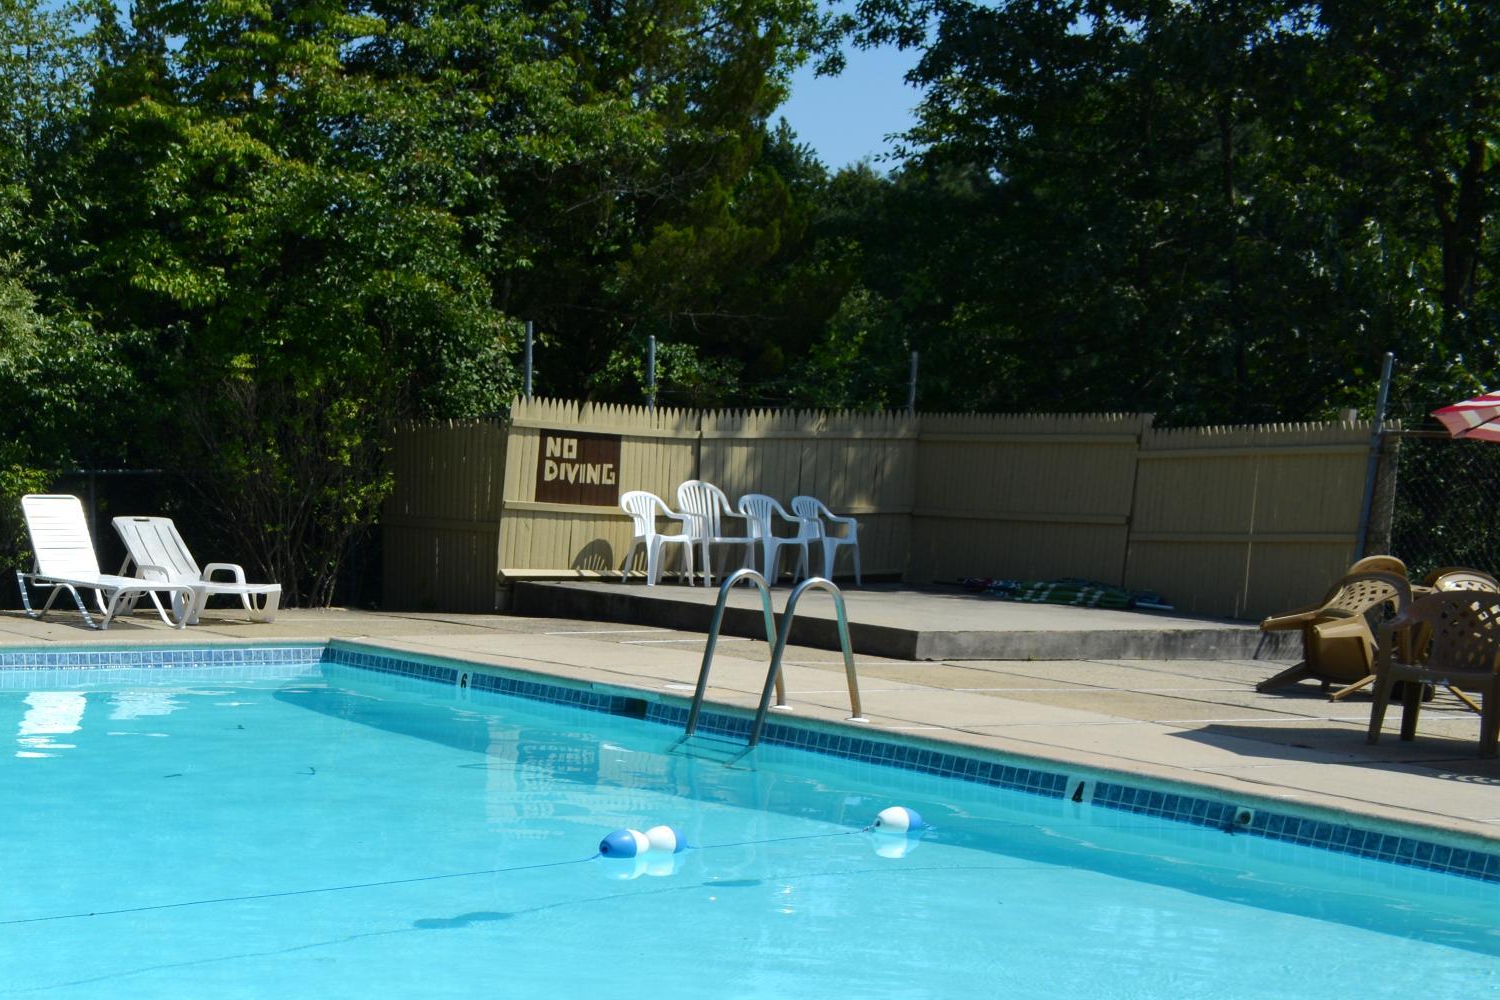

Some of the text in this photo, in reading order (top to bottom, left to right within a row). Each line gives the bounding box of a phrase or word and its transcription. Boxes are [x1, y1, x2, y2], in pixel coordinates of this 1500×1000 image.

[546, 437, 578, 459] NO
[544, 459, 616, 485] DIVING
[460, 673, 468, 689] 6
